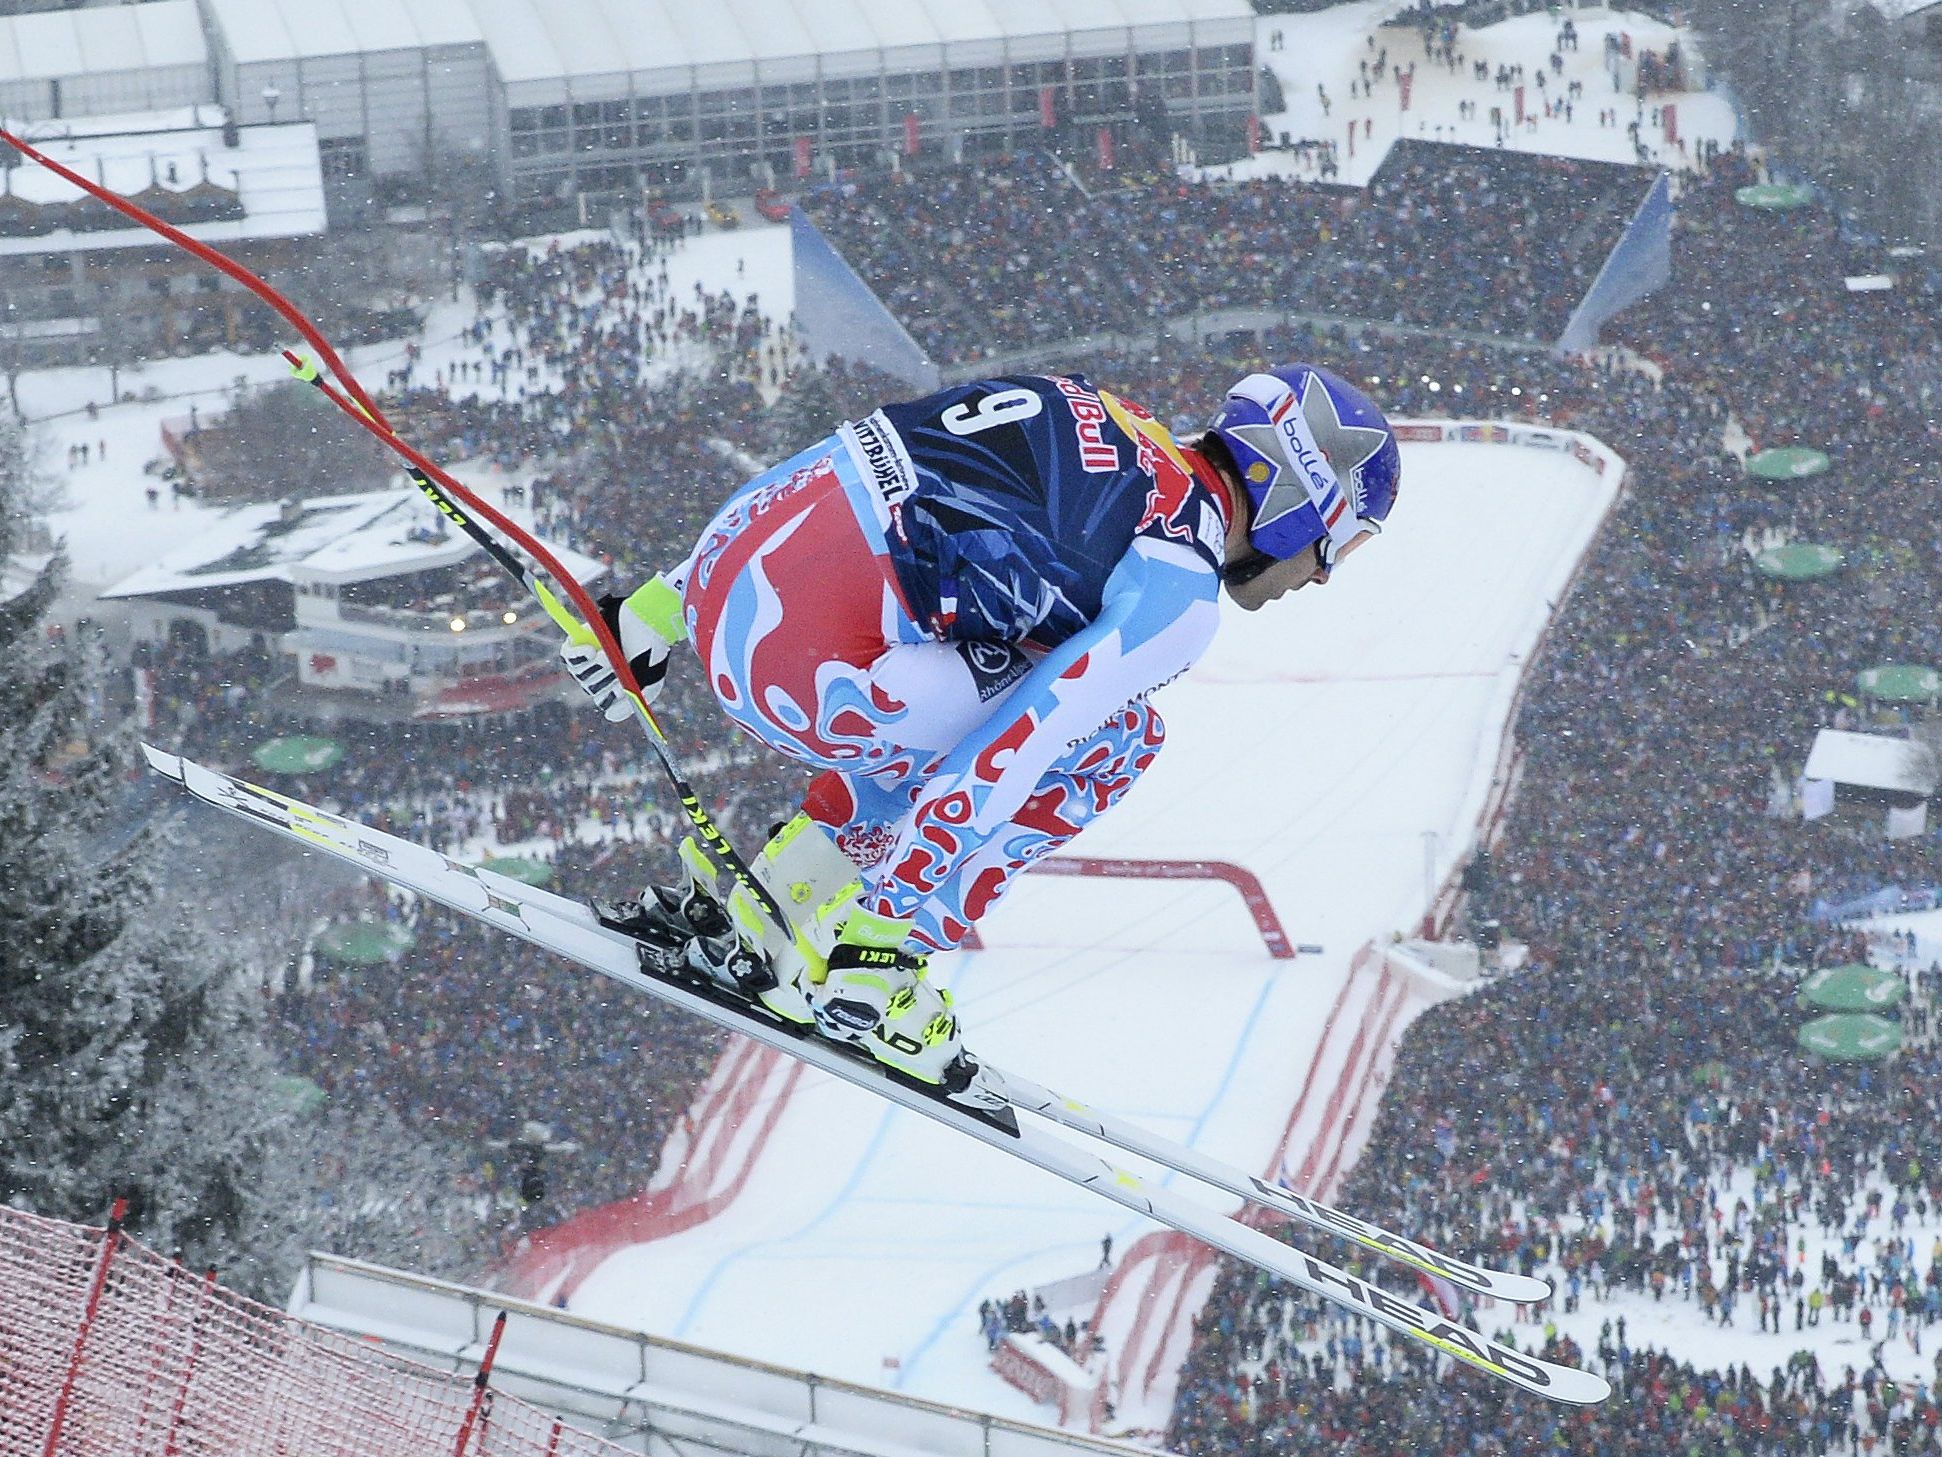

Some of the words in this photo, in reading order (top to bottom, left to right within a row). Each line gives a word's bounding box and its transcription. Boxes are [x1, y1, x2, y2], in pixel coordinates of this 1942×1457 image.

[941, 388, 1043, 435] 9
[1067, 397, 1119, 474] Bull
[1283, 417, 1331, 491] bollé
[681, 796, 732, 855] LEKI
[859, 950, 896, 964] LEKI
[1249, 1176, 1493, 1288] HEAD
[1304, 1257, 1552, 1387] HEAD
